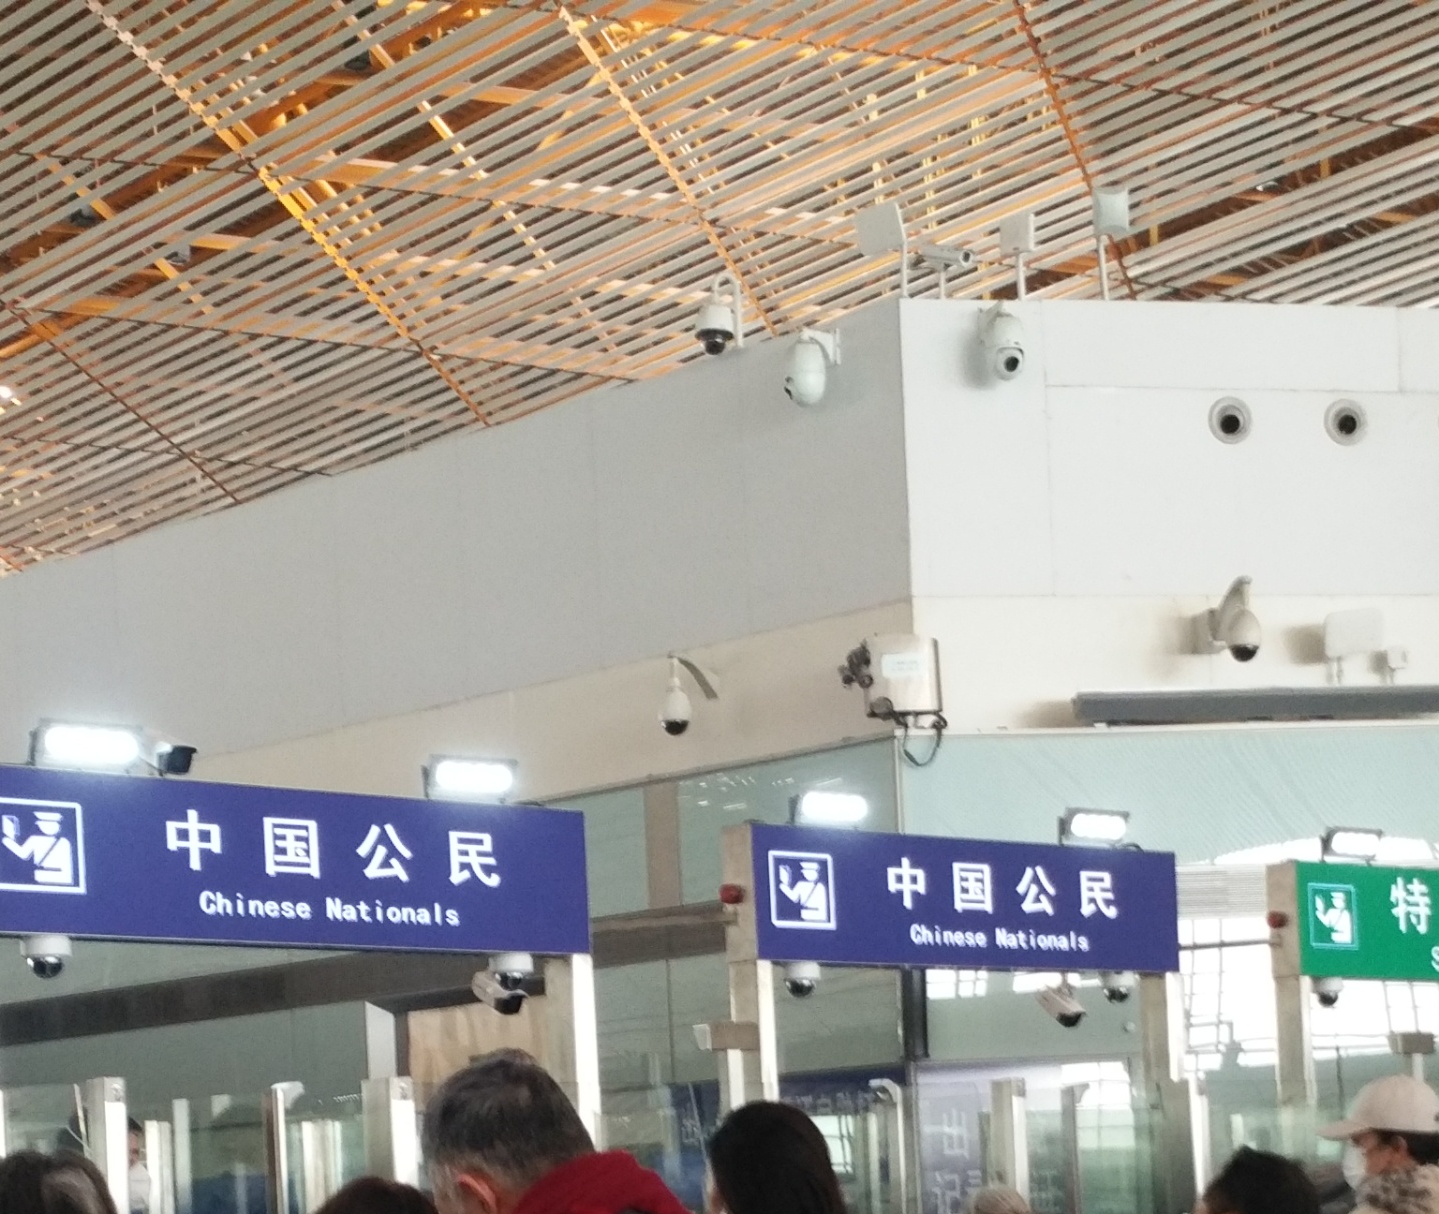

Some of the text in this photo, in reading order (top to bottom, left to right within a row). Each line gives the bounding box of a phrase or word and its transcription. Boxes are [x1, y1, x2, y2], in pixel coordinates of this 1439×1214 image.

[164, 807, 501, 888] 中国公民
[199, 890, 460, 927] Chinese Nationals
[886, 856, 1118, 919] 中国公民
[909, 923, 1090, 952] Chinese Nationals
